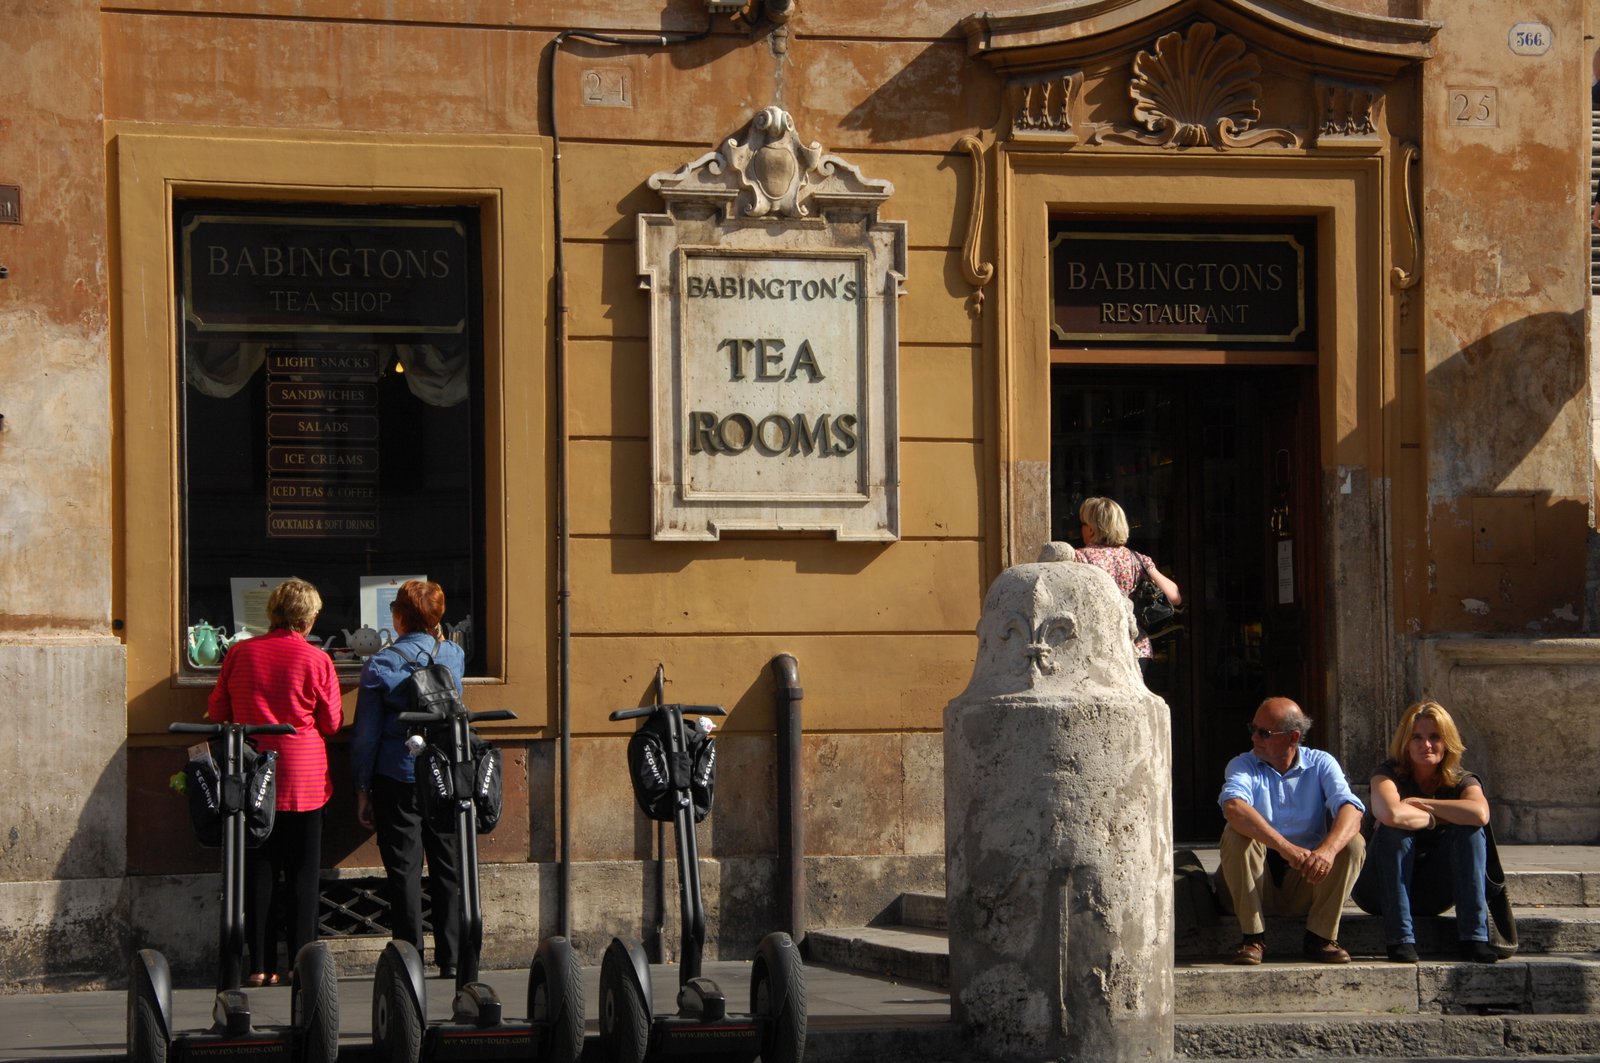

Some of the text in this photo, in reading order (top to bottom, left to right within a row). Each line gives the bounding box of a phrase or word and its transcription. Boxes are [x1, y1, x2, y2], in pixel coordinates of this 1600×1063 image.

[1454, 93, 1491, 121] 25
[207, 245, 450, 279] BABINGTONS
[687, 274, 858, 301] BABINGTON'S
[1067, 262, 1283, 291] BABINGTONS
[270, 291, 393, 313] TEA SHOP
[1101, 303, 1249, 324] RESTAURANT
[276, 357, 369, 368] LIGHT SNACKS
[717, 338, 826, 383] TEA
[281, 389, 365, 400] SANDWICHES
[298, 421, 349, 432] SALADS
[688, 411, 859, 458] ROOMS
[284, 453, 363, 465] ICE CREAMS
[272, 486, 296, 496] ICED
[300, 487, 324, 497] TEAS
[337, 487, 374, 498] COFFEE
[271, 519, 375, 530] COCKTAILS & SOFT DRINKS
[429, 755, 448, 798] SEGWAY
[481, 756, 495, 796] SEGWAY
[643, 744, 664, 785] SEGWAY
[701, 746, 716, 787] SEGWAY
[195, 769, 215, 809] SEGWAY
[254, 768, 273, 808] SEGWAY
